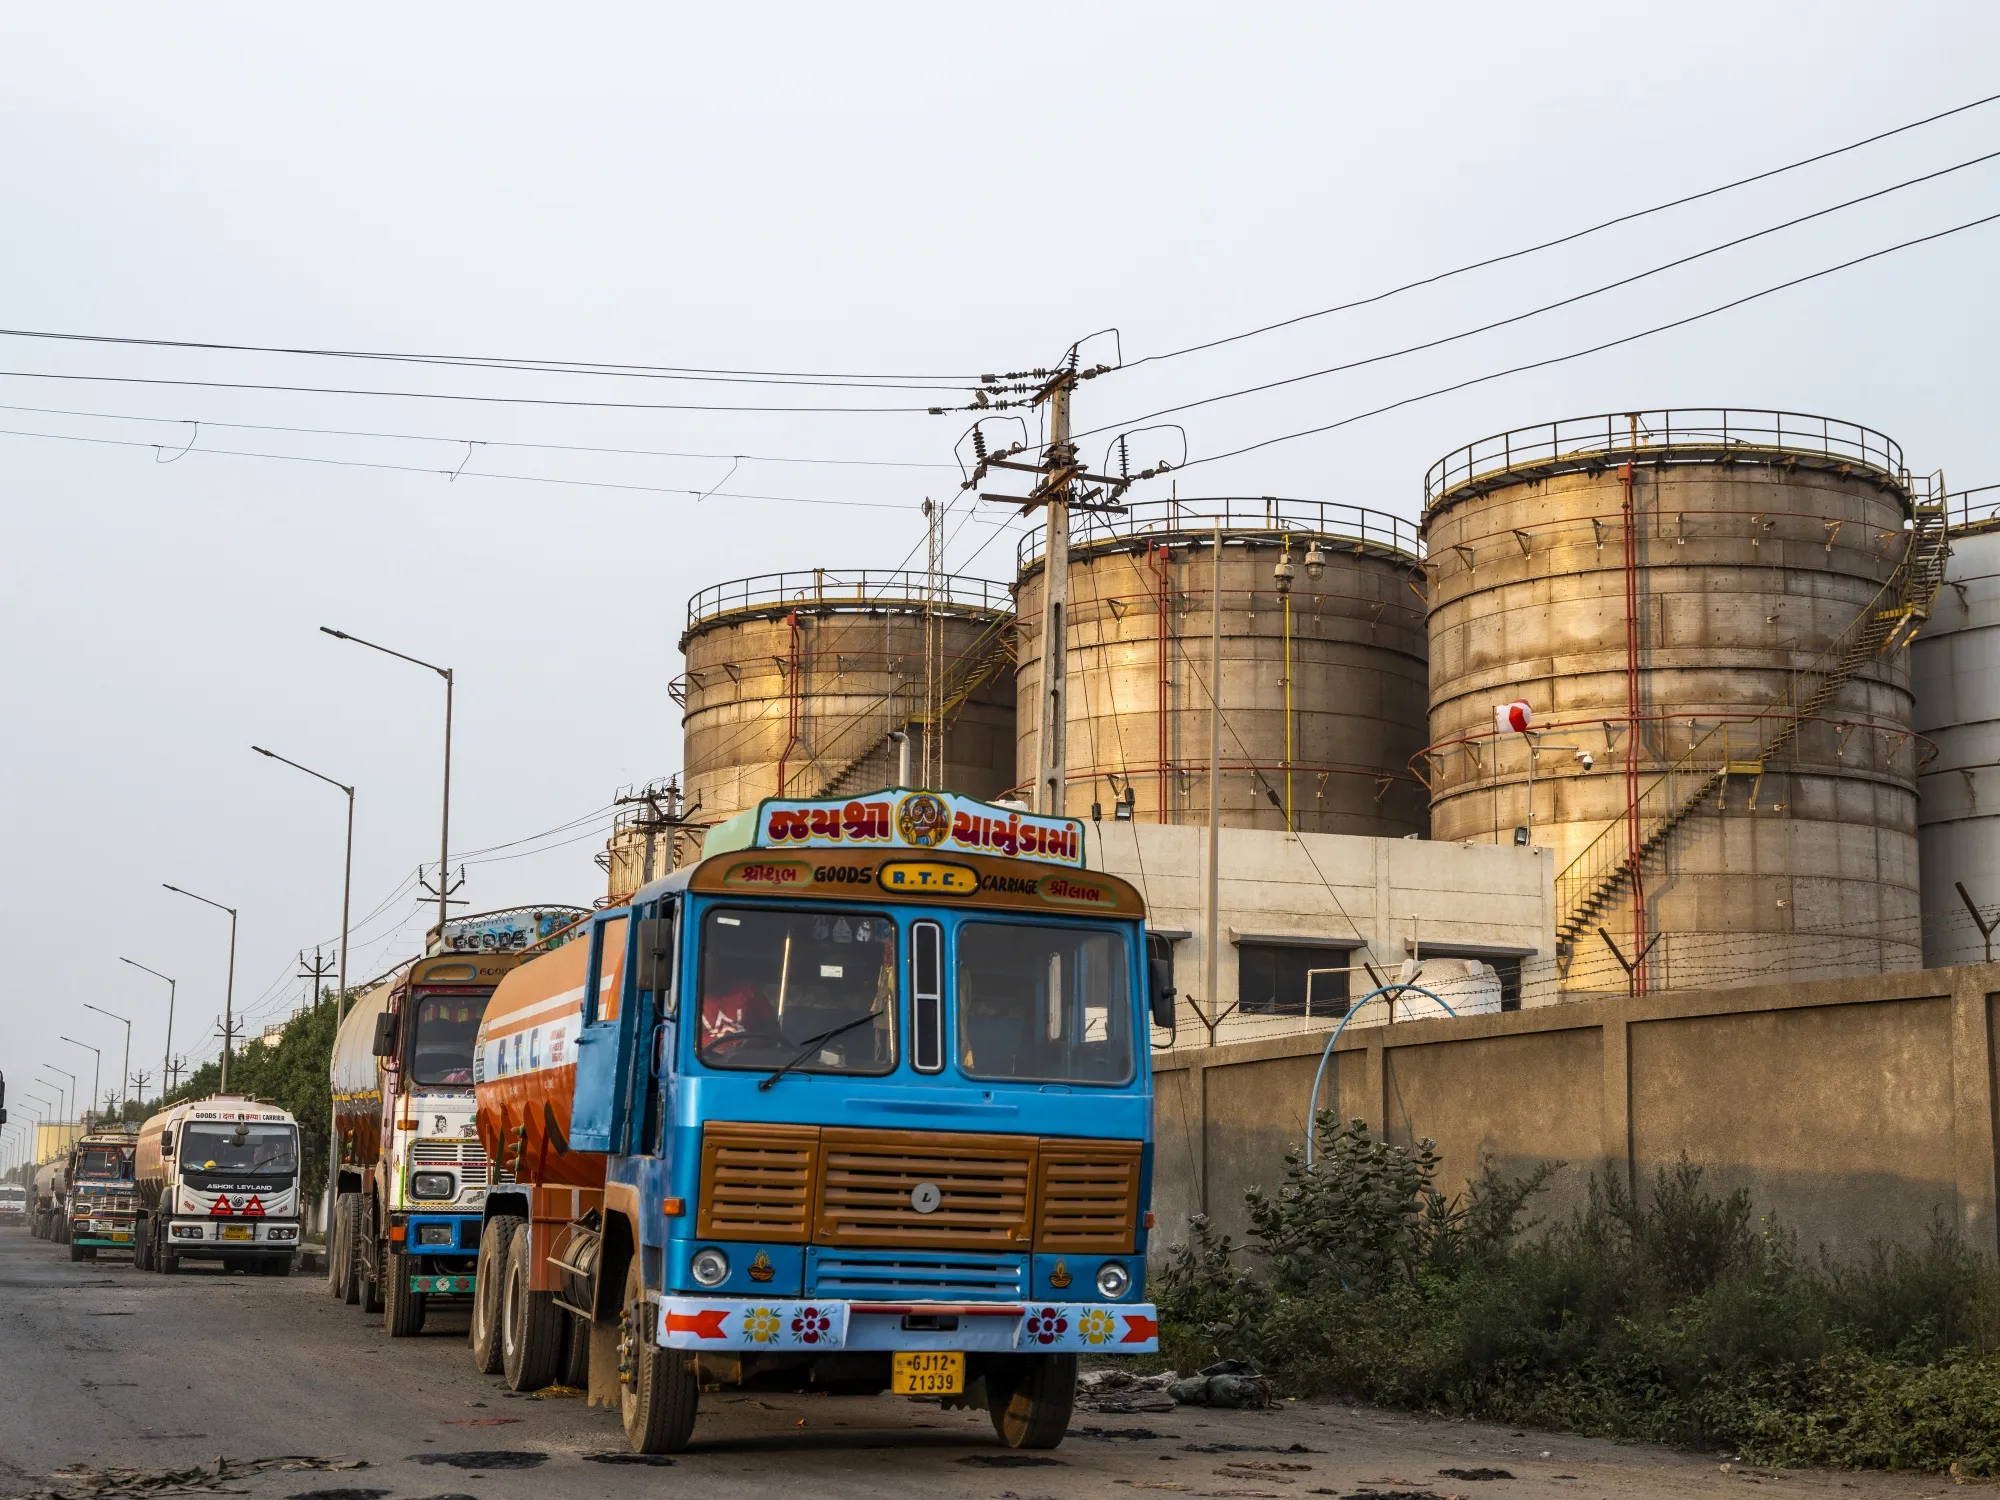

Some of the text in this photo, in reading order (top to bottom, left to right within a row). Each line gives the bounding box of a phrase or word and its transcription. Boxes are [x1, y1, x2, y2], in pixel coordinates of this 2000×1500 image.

[813, 865, 1038, 895] GOODS CARRIAGE
[479, 967, 515, 976] GOOD
[236, 1183, 272, 1191] LEYLAND
[913, 1355, 949, 1371] GJ12
[908, 1374, 954, 1391] Z1339
